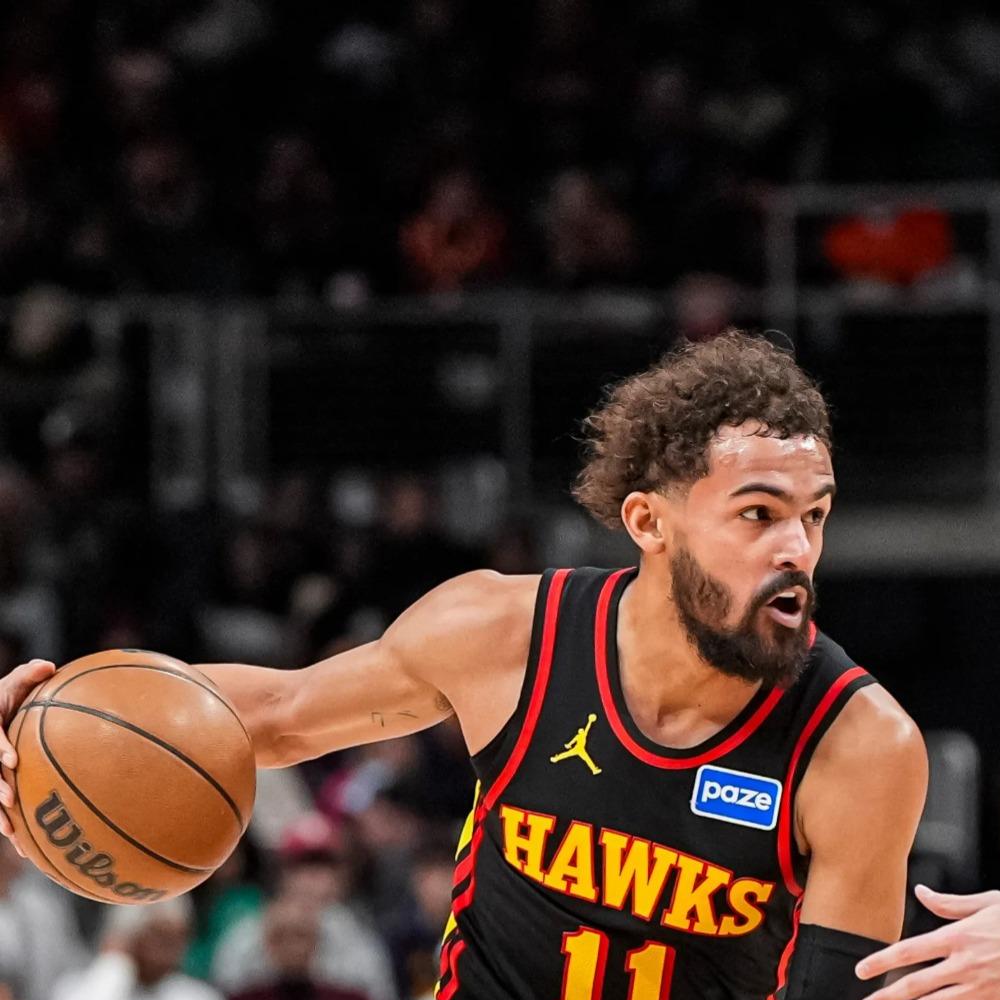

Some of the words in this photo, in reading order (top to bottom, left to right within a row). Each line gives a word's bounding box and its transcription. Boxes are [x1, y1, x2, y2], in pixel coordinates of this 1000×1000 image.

[35, 789, 166, 899] Wilson
[701, 779, 772, 811] paze
[500, 804, 775, 937] HAWKS
